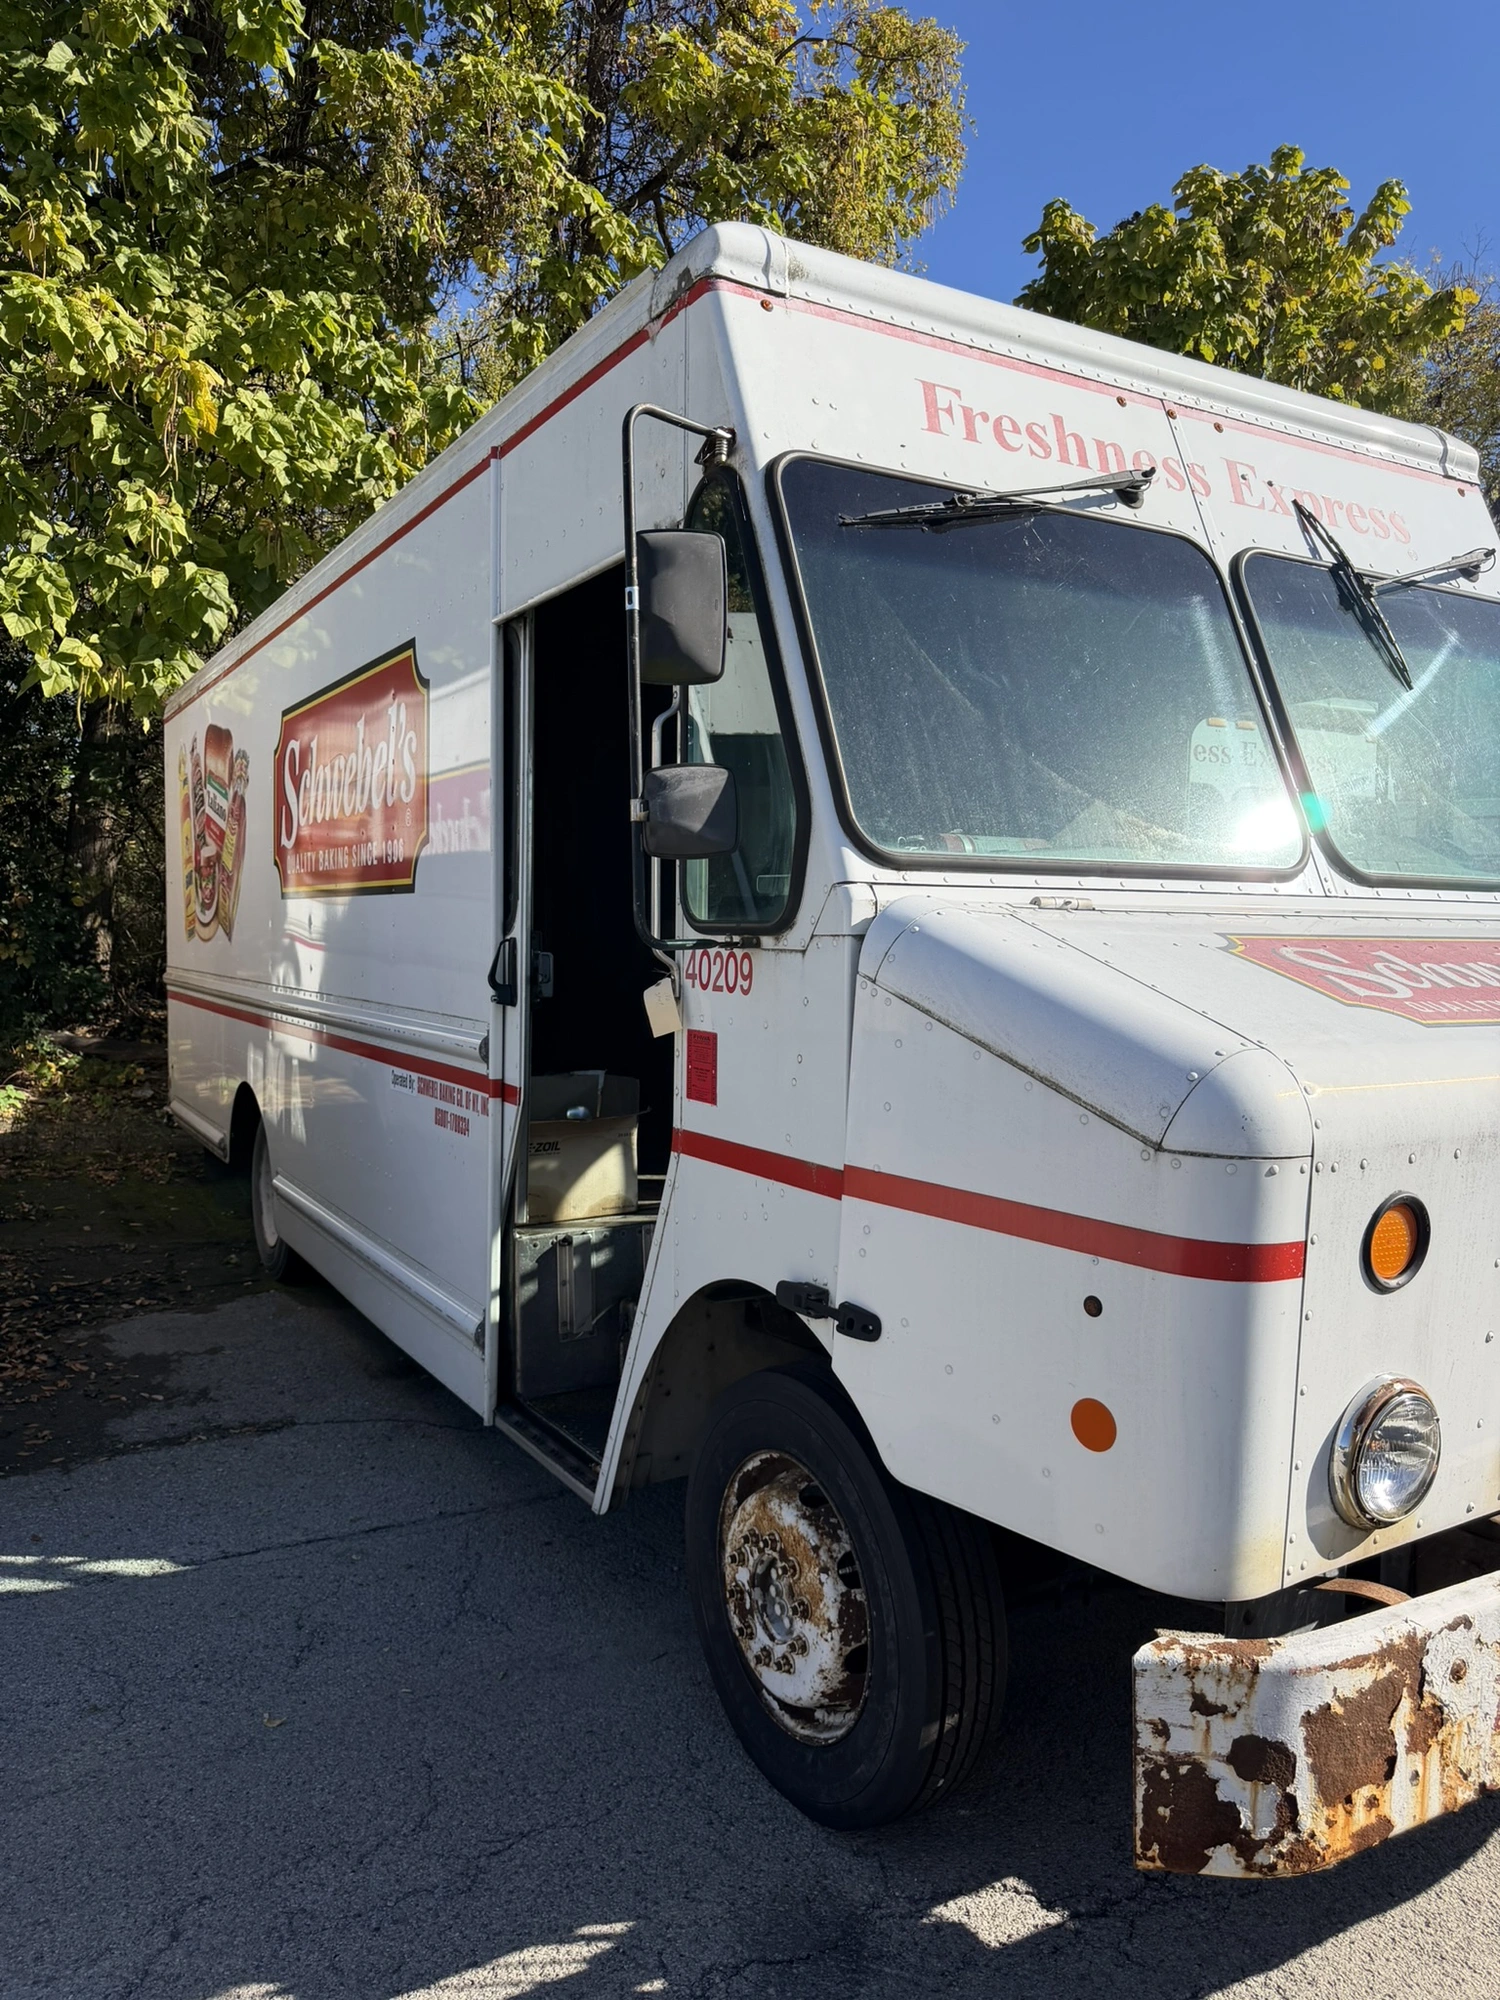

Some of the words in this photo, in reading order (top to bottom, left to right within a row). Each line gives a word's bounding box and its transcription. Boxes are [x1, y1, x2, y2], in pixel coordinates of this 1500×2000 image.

[914, 378, 1211, 498] Freshness
[1220, 457, 1411, 544] Express
[280, 689, 417, 850] Schwebel's
[319, 846, 348, 871] BAKING
[352, 841, 378, 867] SINCE
[382, 838, 405, 865] 1906
[685, 949, 754, 996] 40209
[391, 1069, 408, 1088] Operated
